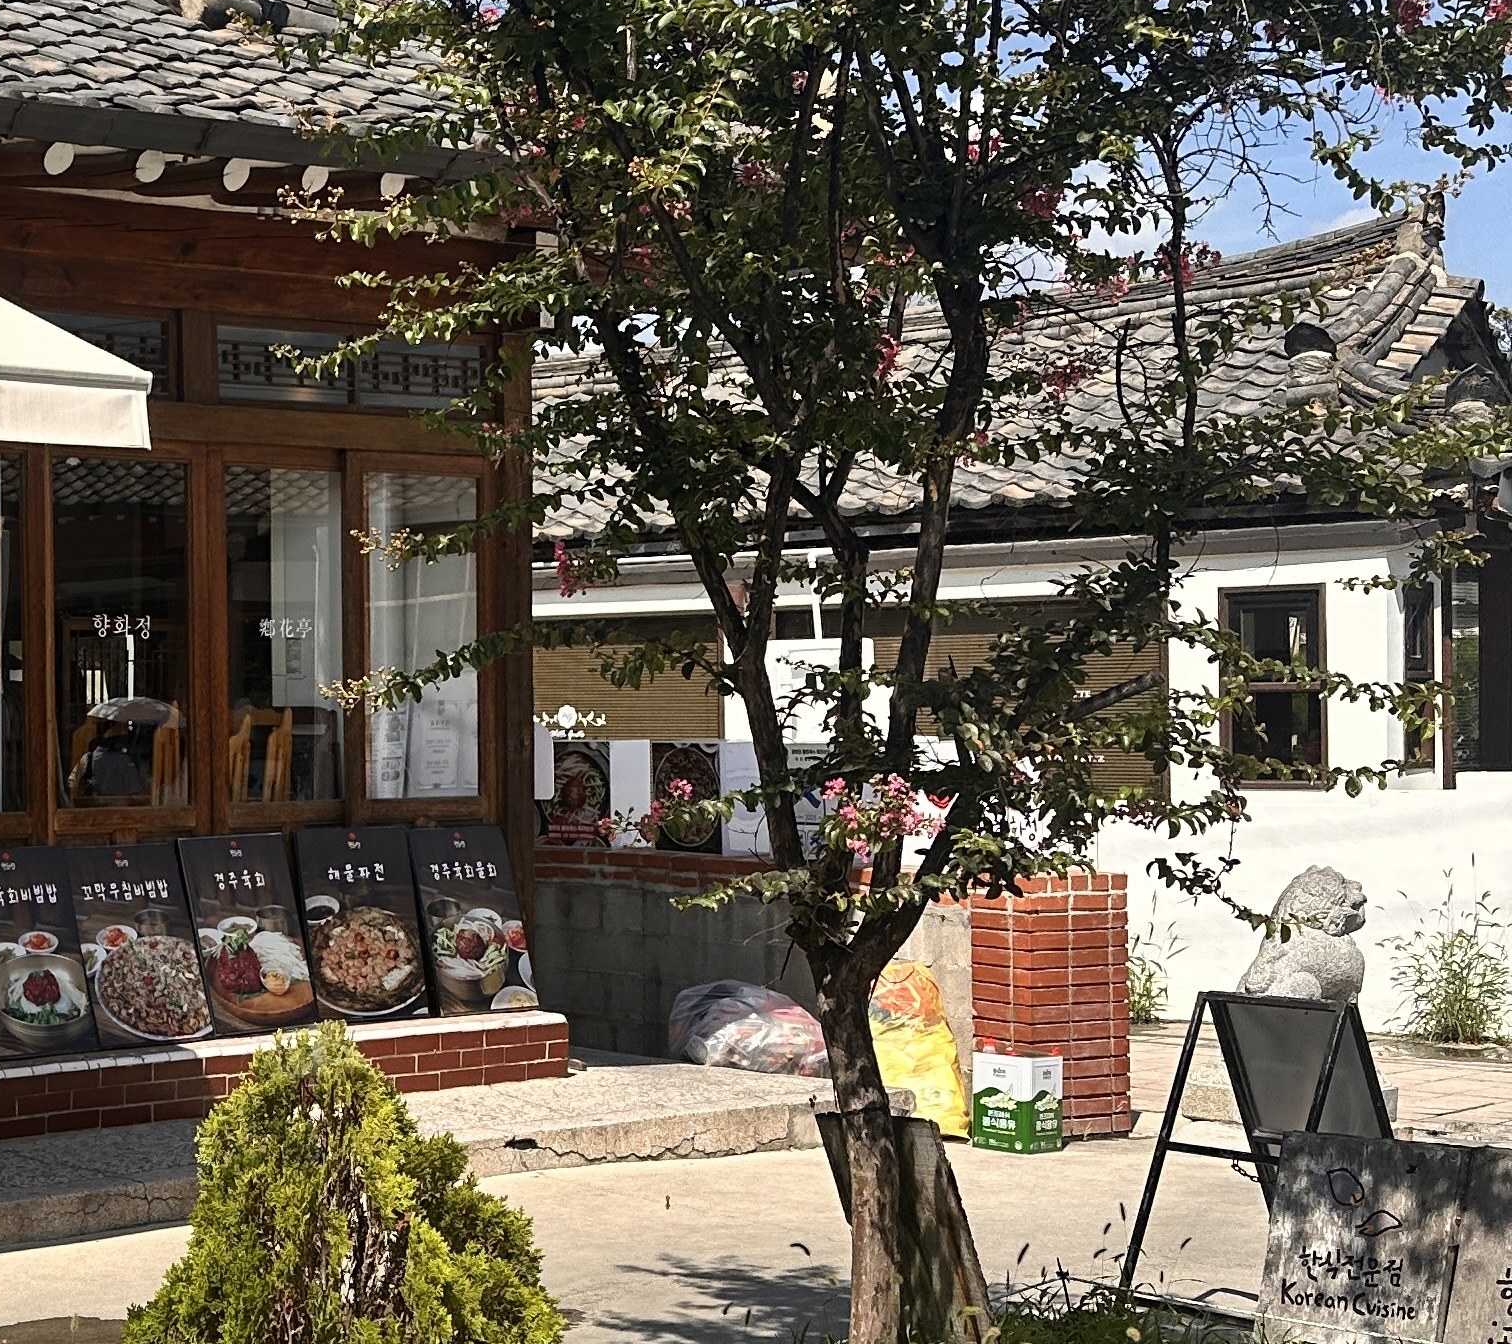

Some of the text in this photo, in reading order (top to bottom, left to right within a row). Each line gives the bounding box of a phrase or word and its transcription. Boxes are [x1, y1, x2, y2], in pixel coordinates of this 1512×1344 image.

[91, 613, 150, 640] 향화정
[214, 869, 266, 890] 경주육회
[327, 863, 385, 883] 해물파전
[430, 861, 497, 880] 경주육회물회
[81, 879, 168, 901] 꼬막무침비빔밥
[1298, 1246, 1403, 1287] 한식전문점
[1281, 1278, 1416, 1320] Korean Cuisine
